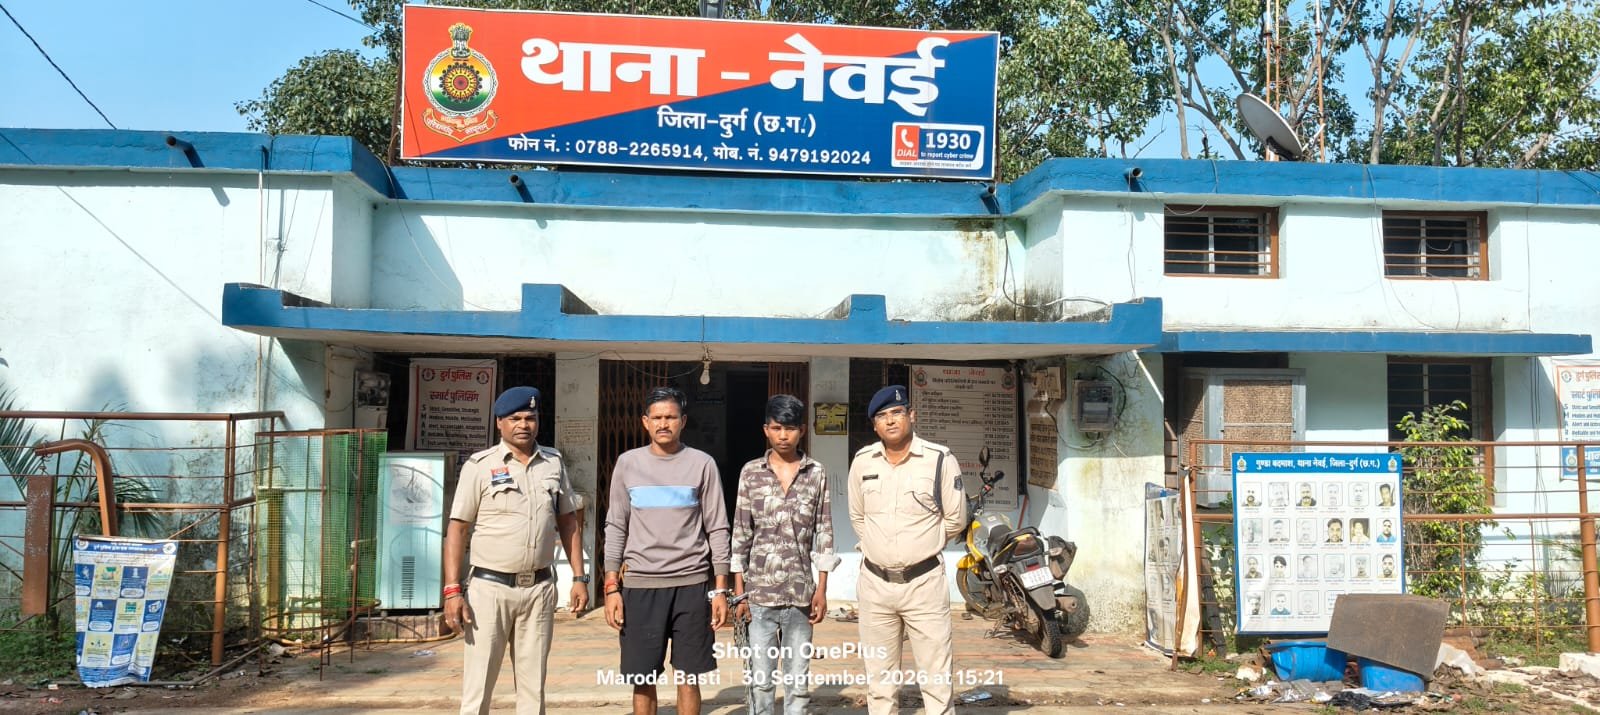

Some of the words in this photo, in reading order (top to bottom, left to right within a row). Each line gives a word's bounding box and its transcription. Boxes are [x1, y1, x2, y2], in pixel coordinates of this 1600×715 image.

[521, 37, 705, 97] थाना
[769, 33, 948, 117] नेवई
[657, 105, 748, 138] जिला-दुर्ग
[754, 111, 816, 138] (छ.ग.)
[508, 133, 540, 151] फोन
[544, 134, 560, 152] नं.
[575, 139, 708, 162] 0788-2265914,
[713, 142, 743, 160] मोब.
[748, 143, 763, 161] नं.
[769, 147, 871, 165] 9479192024
[925, 132, 971, 150] 1930
[896, 149, 917, 157] DIAL
[944, 152, 958, 160] cyber
[440, 368, 451, 383] दुर्ग
[451, 369, 472, 383] पुलिस
